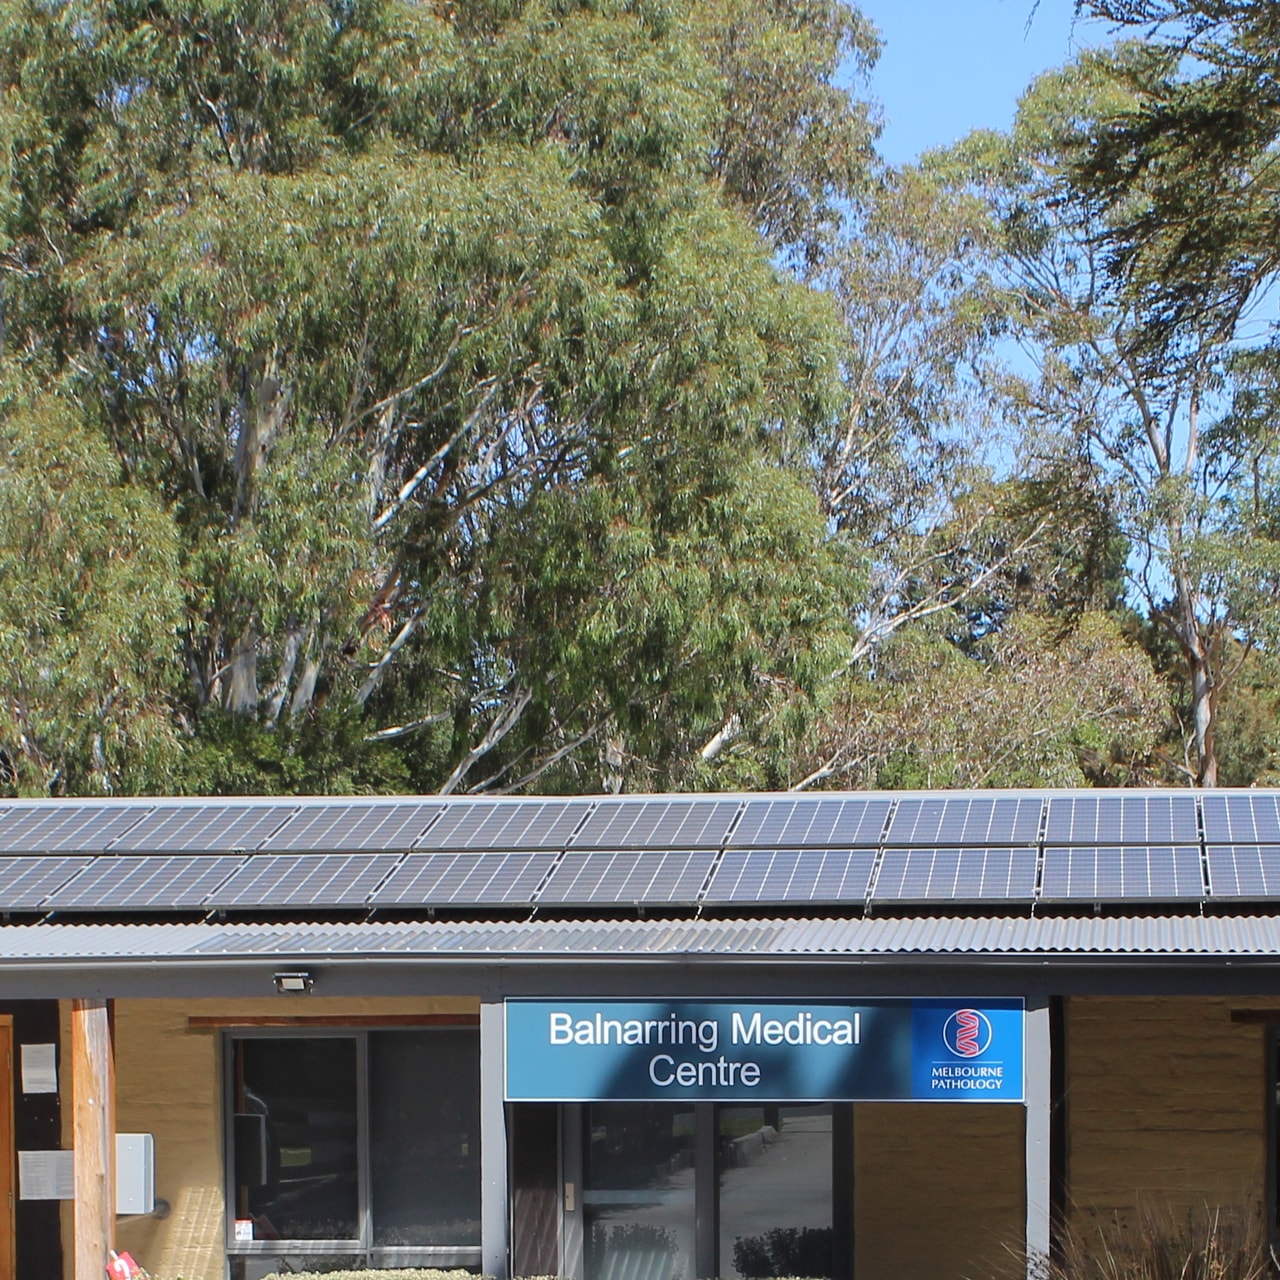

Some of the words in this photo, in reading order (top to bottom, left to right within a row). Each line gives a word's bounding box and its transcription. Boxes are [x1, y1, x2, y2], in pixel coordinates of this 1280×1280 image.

[549, 1012, 718, 1052] Balnarring
[731, 1012, 861, 1045] Medical
[648, 1054, 761, 1087] Centre
[931, 1066, 1004, 1077] MELBOURNE
[931, 1079, 1004, 1090] PATHOLOGY
